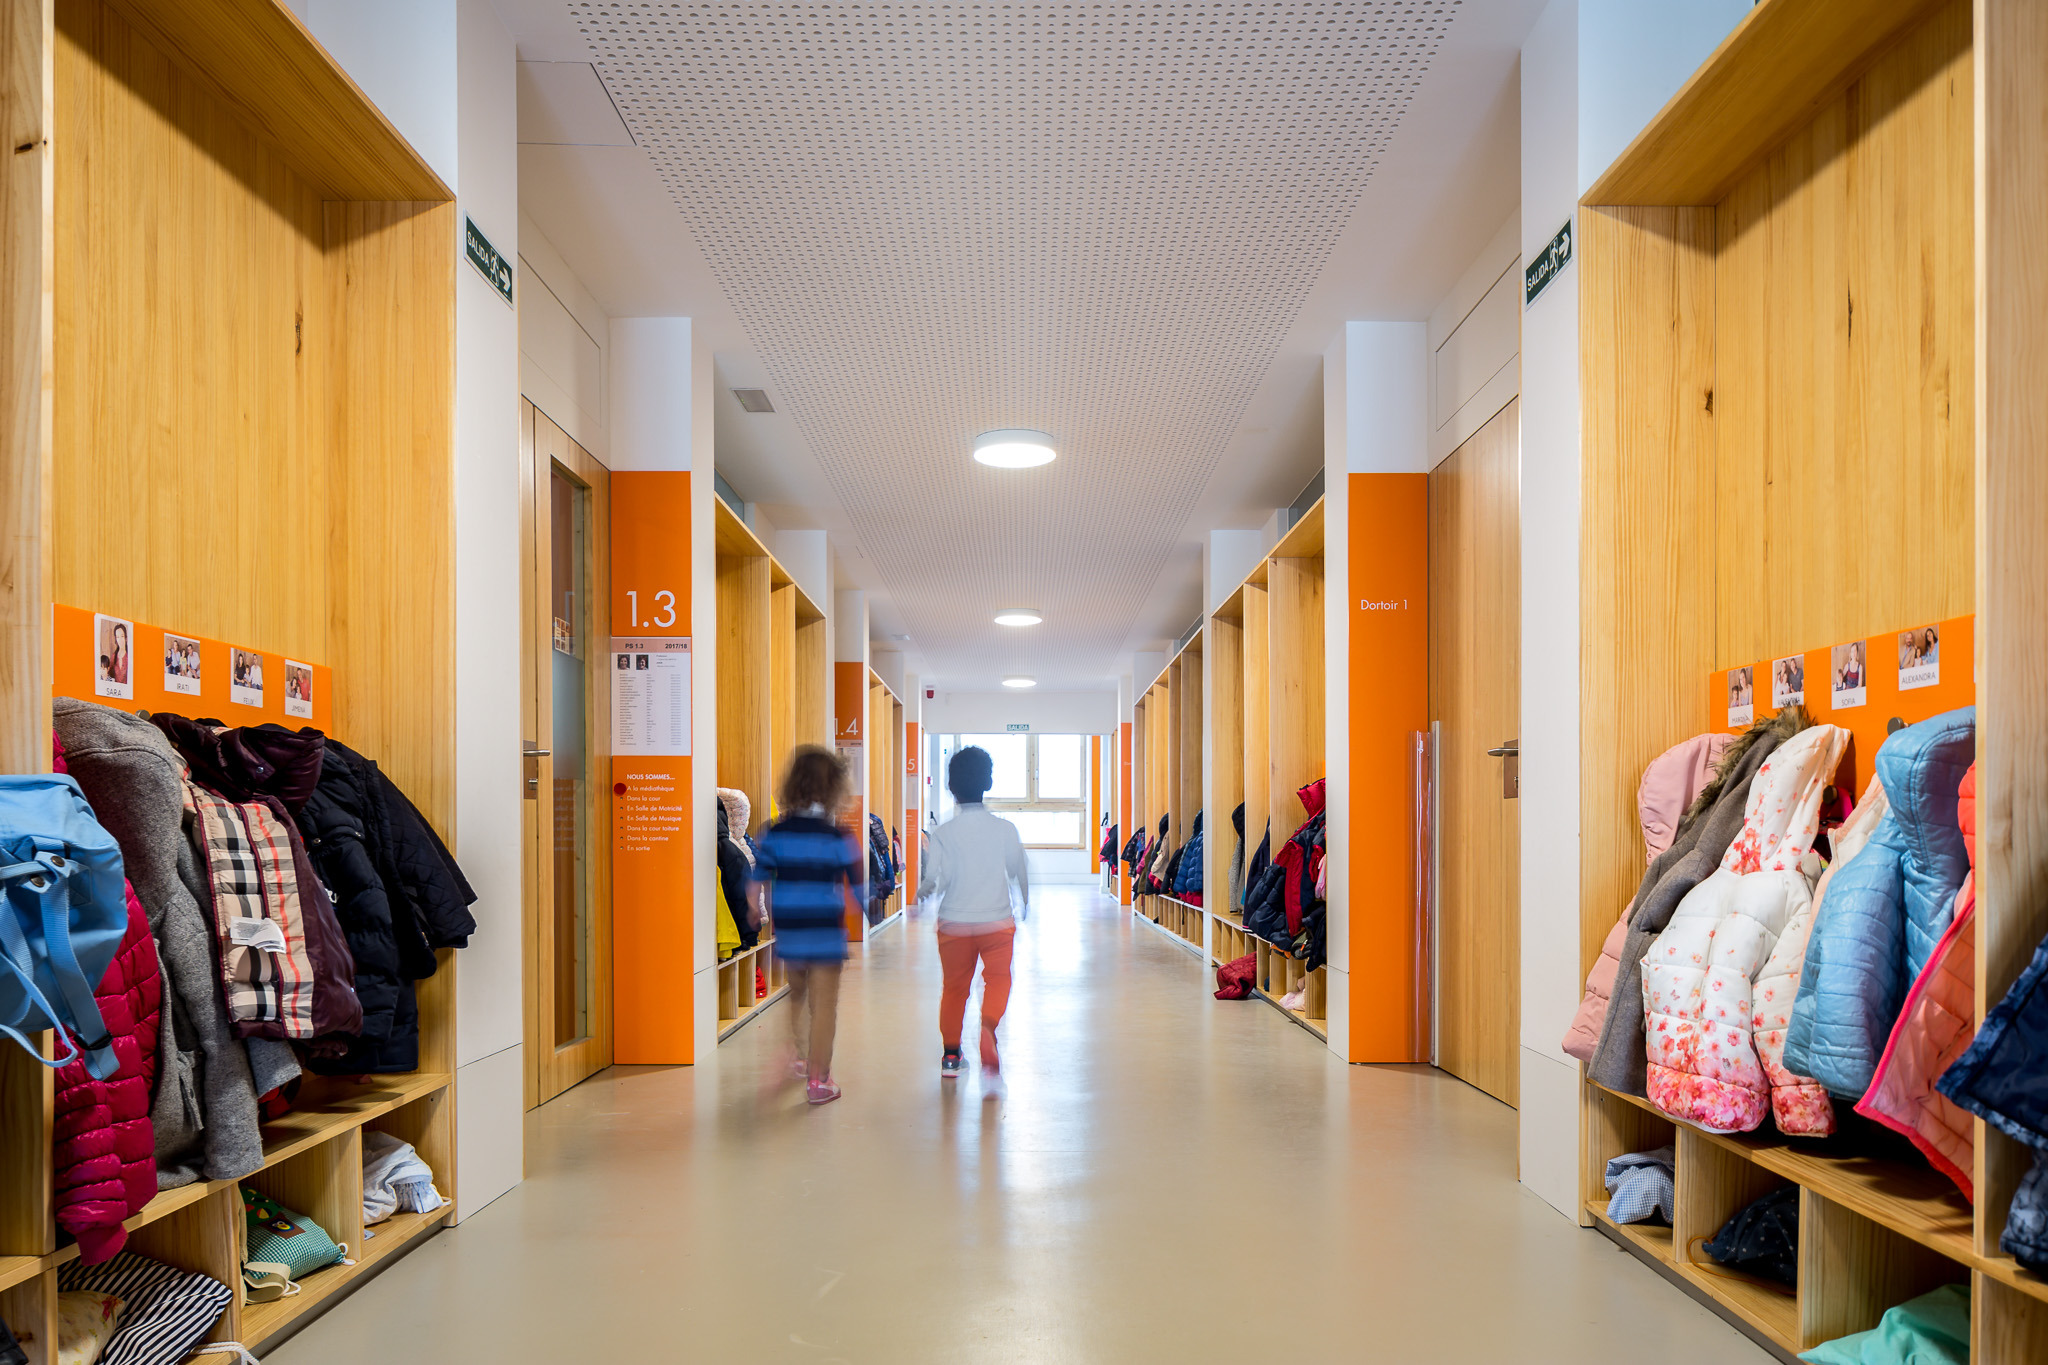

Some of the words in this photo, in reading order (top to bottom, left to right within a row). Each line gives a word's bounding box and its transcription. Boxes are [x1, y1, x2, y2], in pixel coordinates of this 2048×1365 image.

[467, 230, 490, 268] SALIDA
[1527, 260, 1549, 292] SALIDA
[626, 590, 676, 627] 1.3
[1360, 599, 1399, 610] Dortoir
[1403, 599, 1408, 610] 1
[1901, 671, 1937, 685] ALEXANDRA
[106, 687, 122, 697] SARA
[176, 683, 190, 692] IRATI
